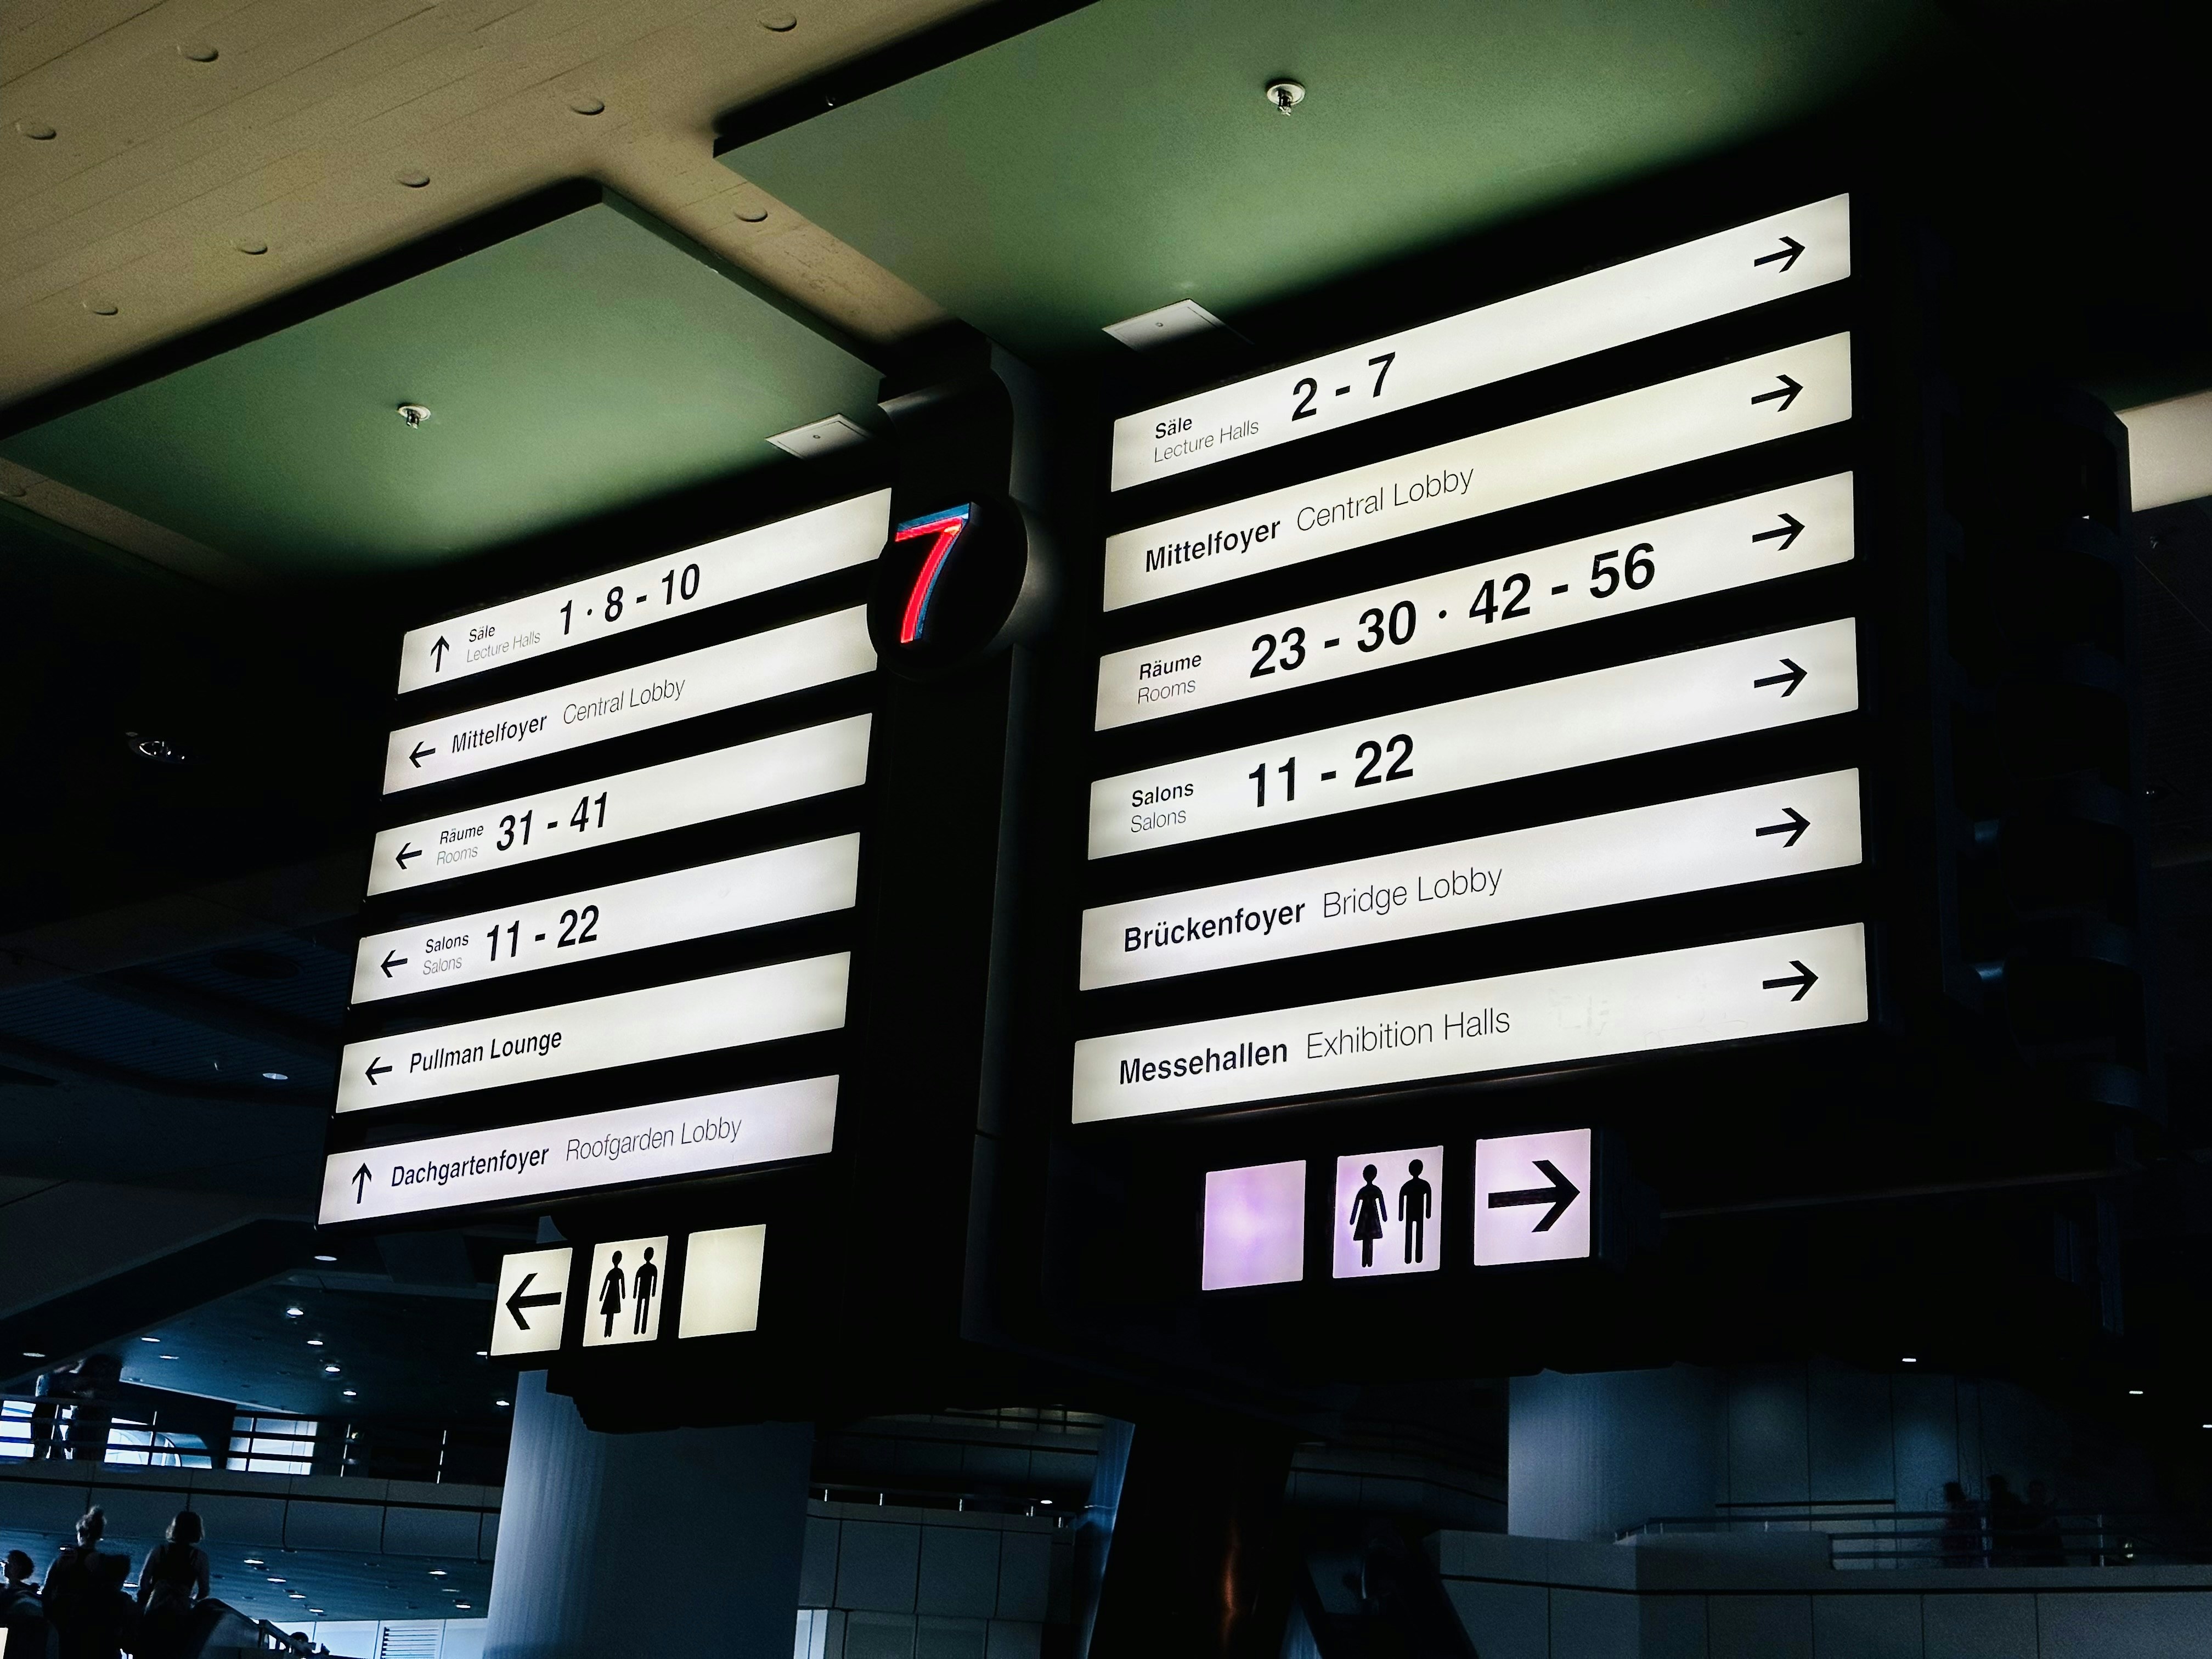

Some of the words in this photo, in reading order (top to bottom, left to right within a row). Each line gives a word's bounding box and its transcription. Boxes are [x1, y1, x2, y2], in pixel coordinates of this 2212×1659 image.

[1291, 377, 1318, 422] 2
[1368, 351, 1396, 398] 7
[1154, 428, 1214, 464] Lecture
[1220, 420, 1259, 444] Halls
[1155, 417, 1193, 439] Säle
[1144, 517, 1282, 573] Mittelfoyer
[1297, 486, 1383, 531] Central
[1394, 468, 1474, 506] Lobby
[893, 501, 973, 645] 7
[560, 599, 573, 635] 1
[605, 585, 624, 623] 8
[661, 563, 700, 606] 10
[1249, 627, 1306, 679] 23
[1357, 600, 1417, 653] 30
[1469, 573, 1531, 625] 42
[1589, 542, 1655, 599] 56
[466, 641, 510, 663] Lecture
[513, 631, 540, 650] Halls
[469, 625, 495, 642] Säle
[1139, 654, 1202, 681] Räume
[1137, 680, 1196, 706] Rooms
[452, 715, 548, 754] Mittelfoyer
[563, 690, 624, 724] Central
[630, 679, 686, 708] Lobby
[1249, 756, 1296, 808] 11
[1354, 733, 1414, 788] 22
[1131, 783, 1194, 808] Salons
[439, 825, 484, 845] Räume
[496, 809, 533, 851] 31
[569, 791, 608, 833] 41
[1131, 810, 1186, 833] Salons
[436, 846, 478, 866] Rooms
[1124, 900, 1306, 953] Brückenfoyer
[1324, 884, 1407, 918] Bridge
[1418, 866, 1503, 902] Lobby
[425, 934, 469, 953] Salons
[487, 919, 520, 962] 11
[557, 905, 599, 949] 22
[422, 957, 462, 975] Salons
[409, 1046, 483, 1074] Pullman
[490, 1031, 562, 1059] Lounge
[1120, 1041, 1287, 1085] Messehallen
[1307, 1020, 1432, 1059] Exhibition
[1444, 1007, 1510, 1041] Halls
[391, 1148, 550, 1187] Dachgartenfoyer
[566, 1127, 674, 1162] Roofgarden
[681, 1116, 742, 1145] Lobby
